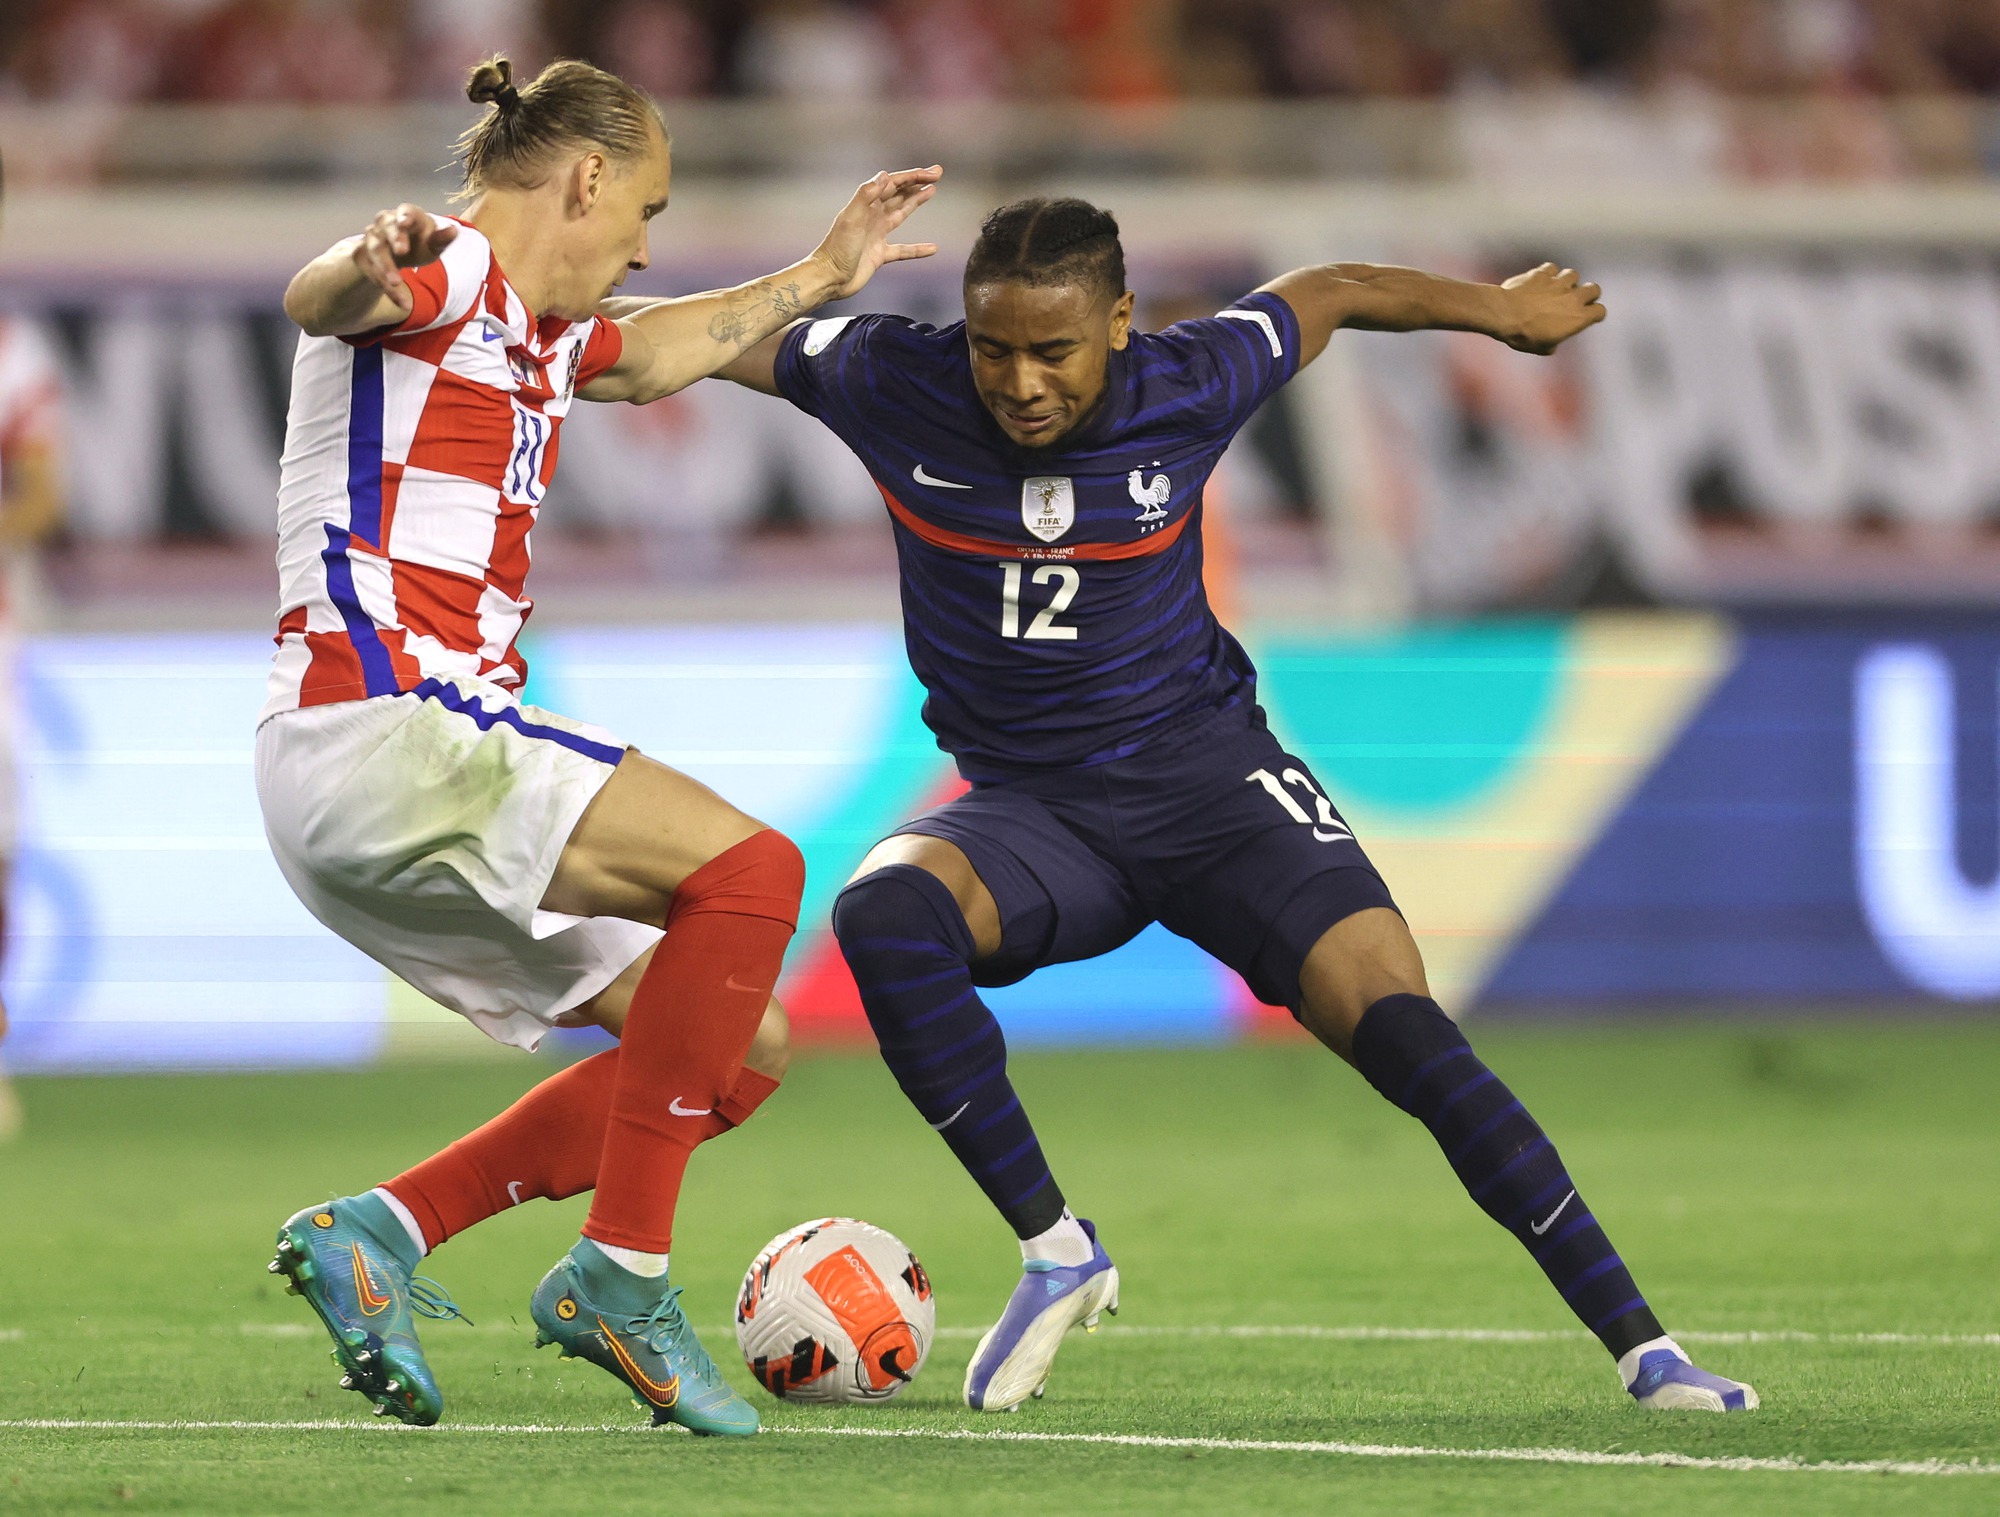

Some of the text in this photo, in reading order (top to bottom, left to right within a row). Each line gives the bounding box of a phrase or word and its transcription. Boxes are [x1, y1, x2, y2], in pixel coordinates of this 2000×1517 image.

[1038, 517, 1061, 526] FIFA
[1050, 547, 1075, 556] FRANCE
[999, 561, 1081, 641] 12
[1245, 767, 1355, 843] 12
